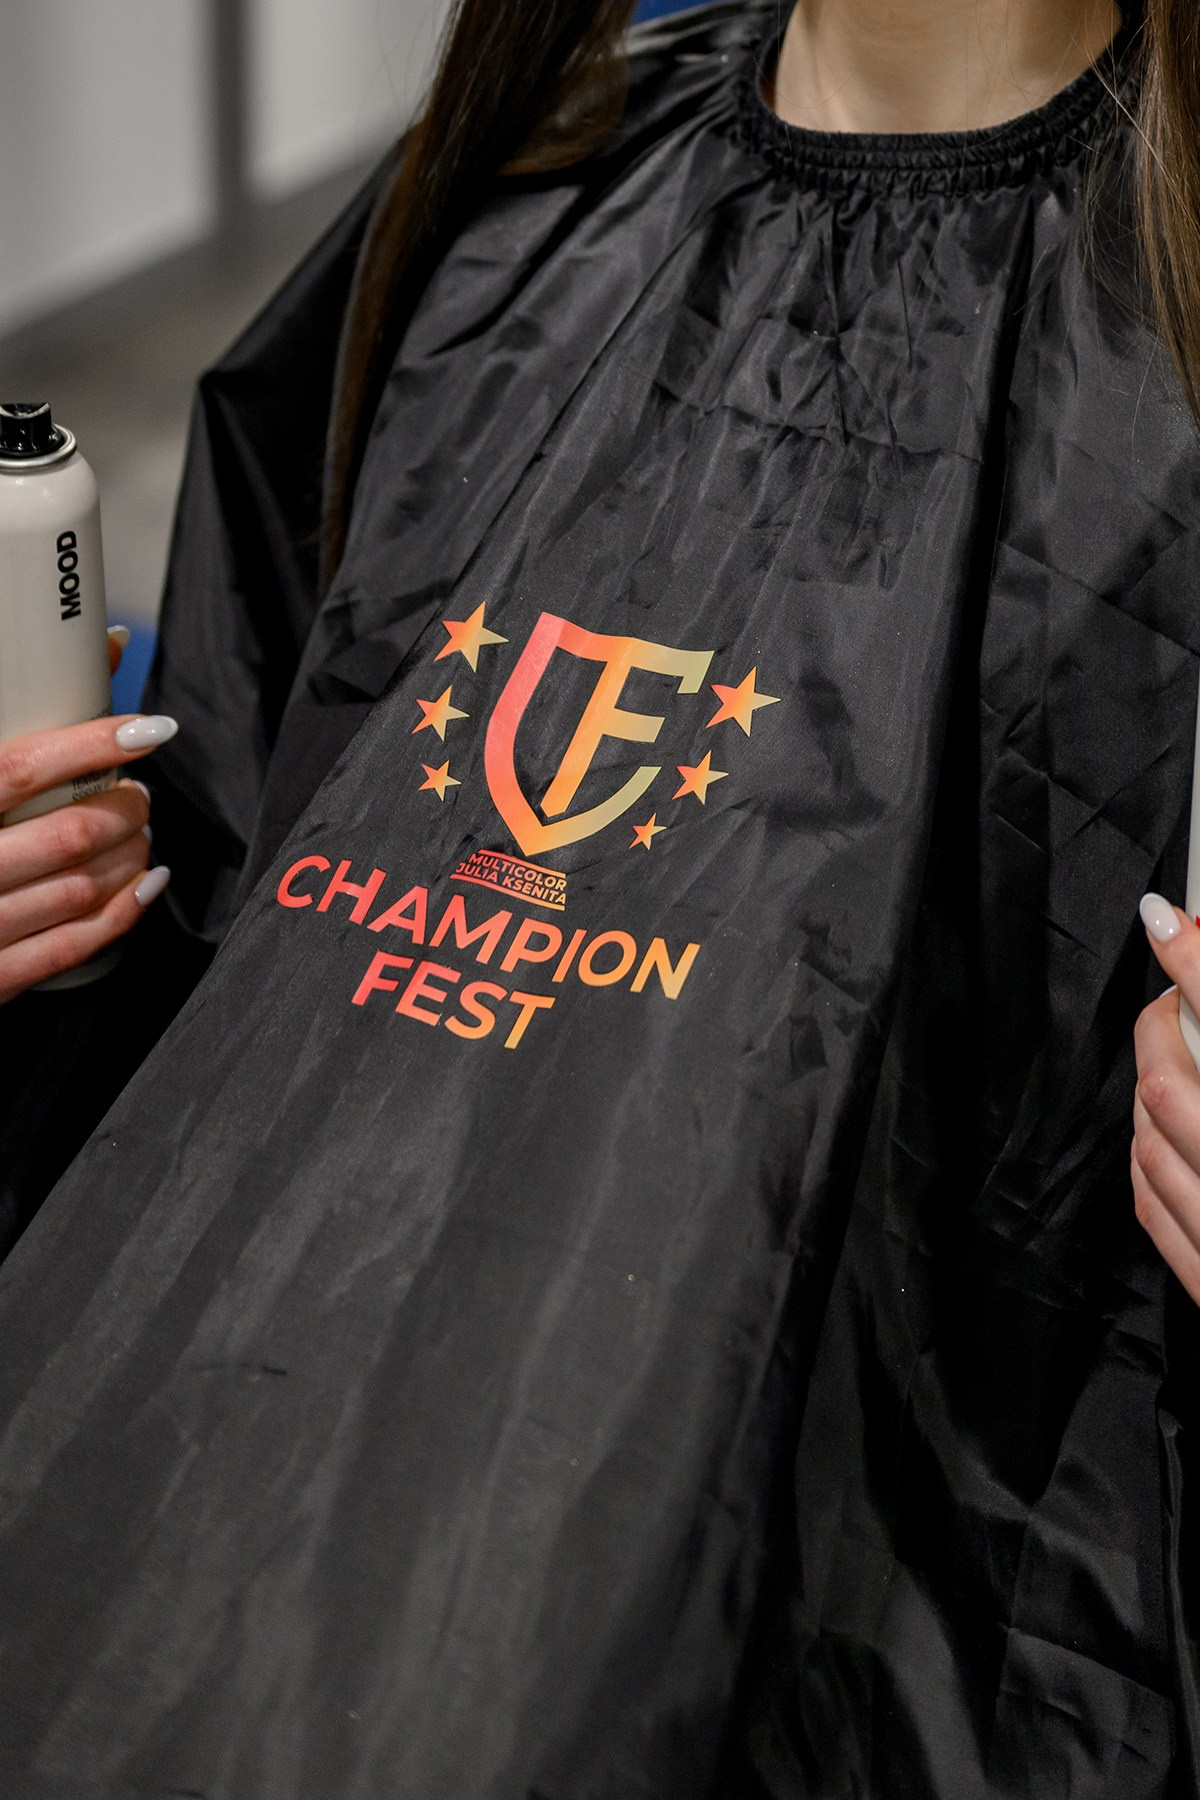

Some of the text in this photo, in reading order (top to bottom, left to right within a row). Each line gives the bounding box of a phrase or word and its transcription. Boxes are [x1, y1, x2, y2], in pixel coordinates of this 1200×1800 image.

[56, 529, 81, 622] MOOD
[455, 862, 567, 905] JULIA KSENITA
[468, 853, 567, 891] MULTICOLOR
[276, 854, 701, 1001] CHAMPION
[351, 950, 556, 1050] FEST
